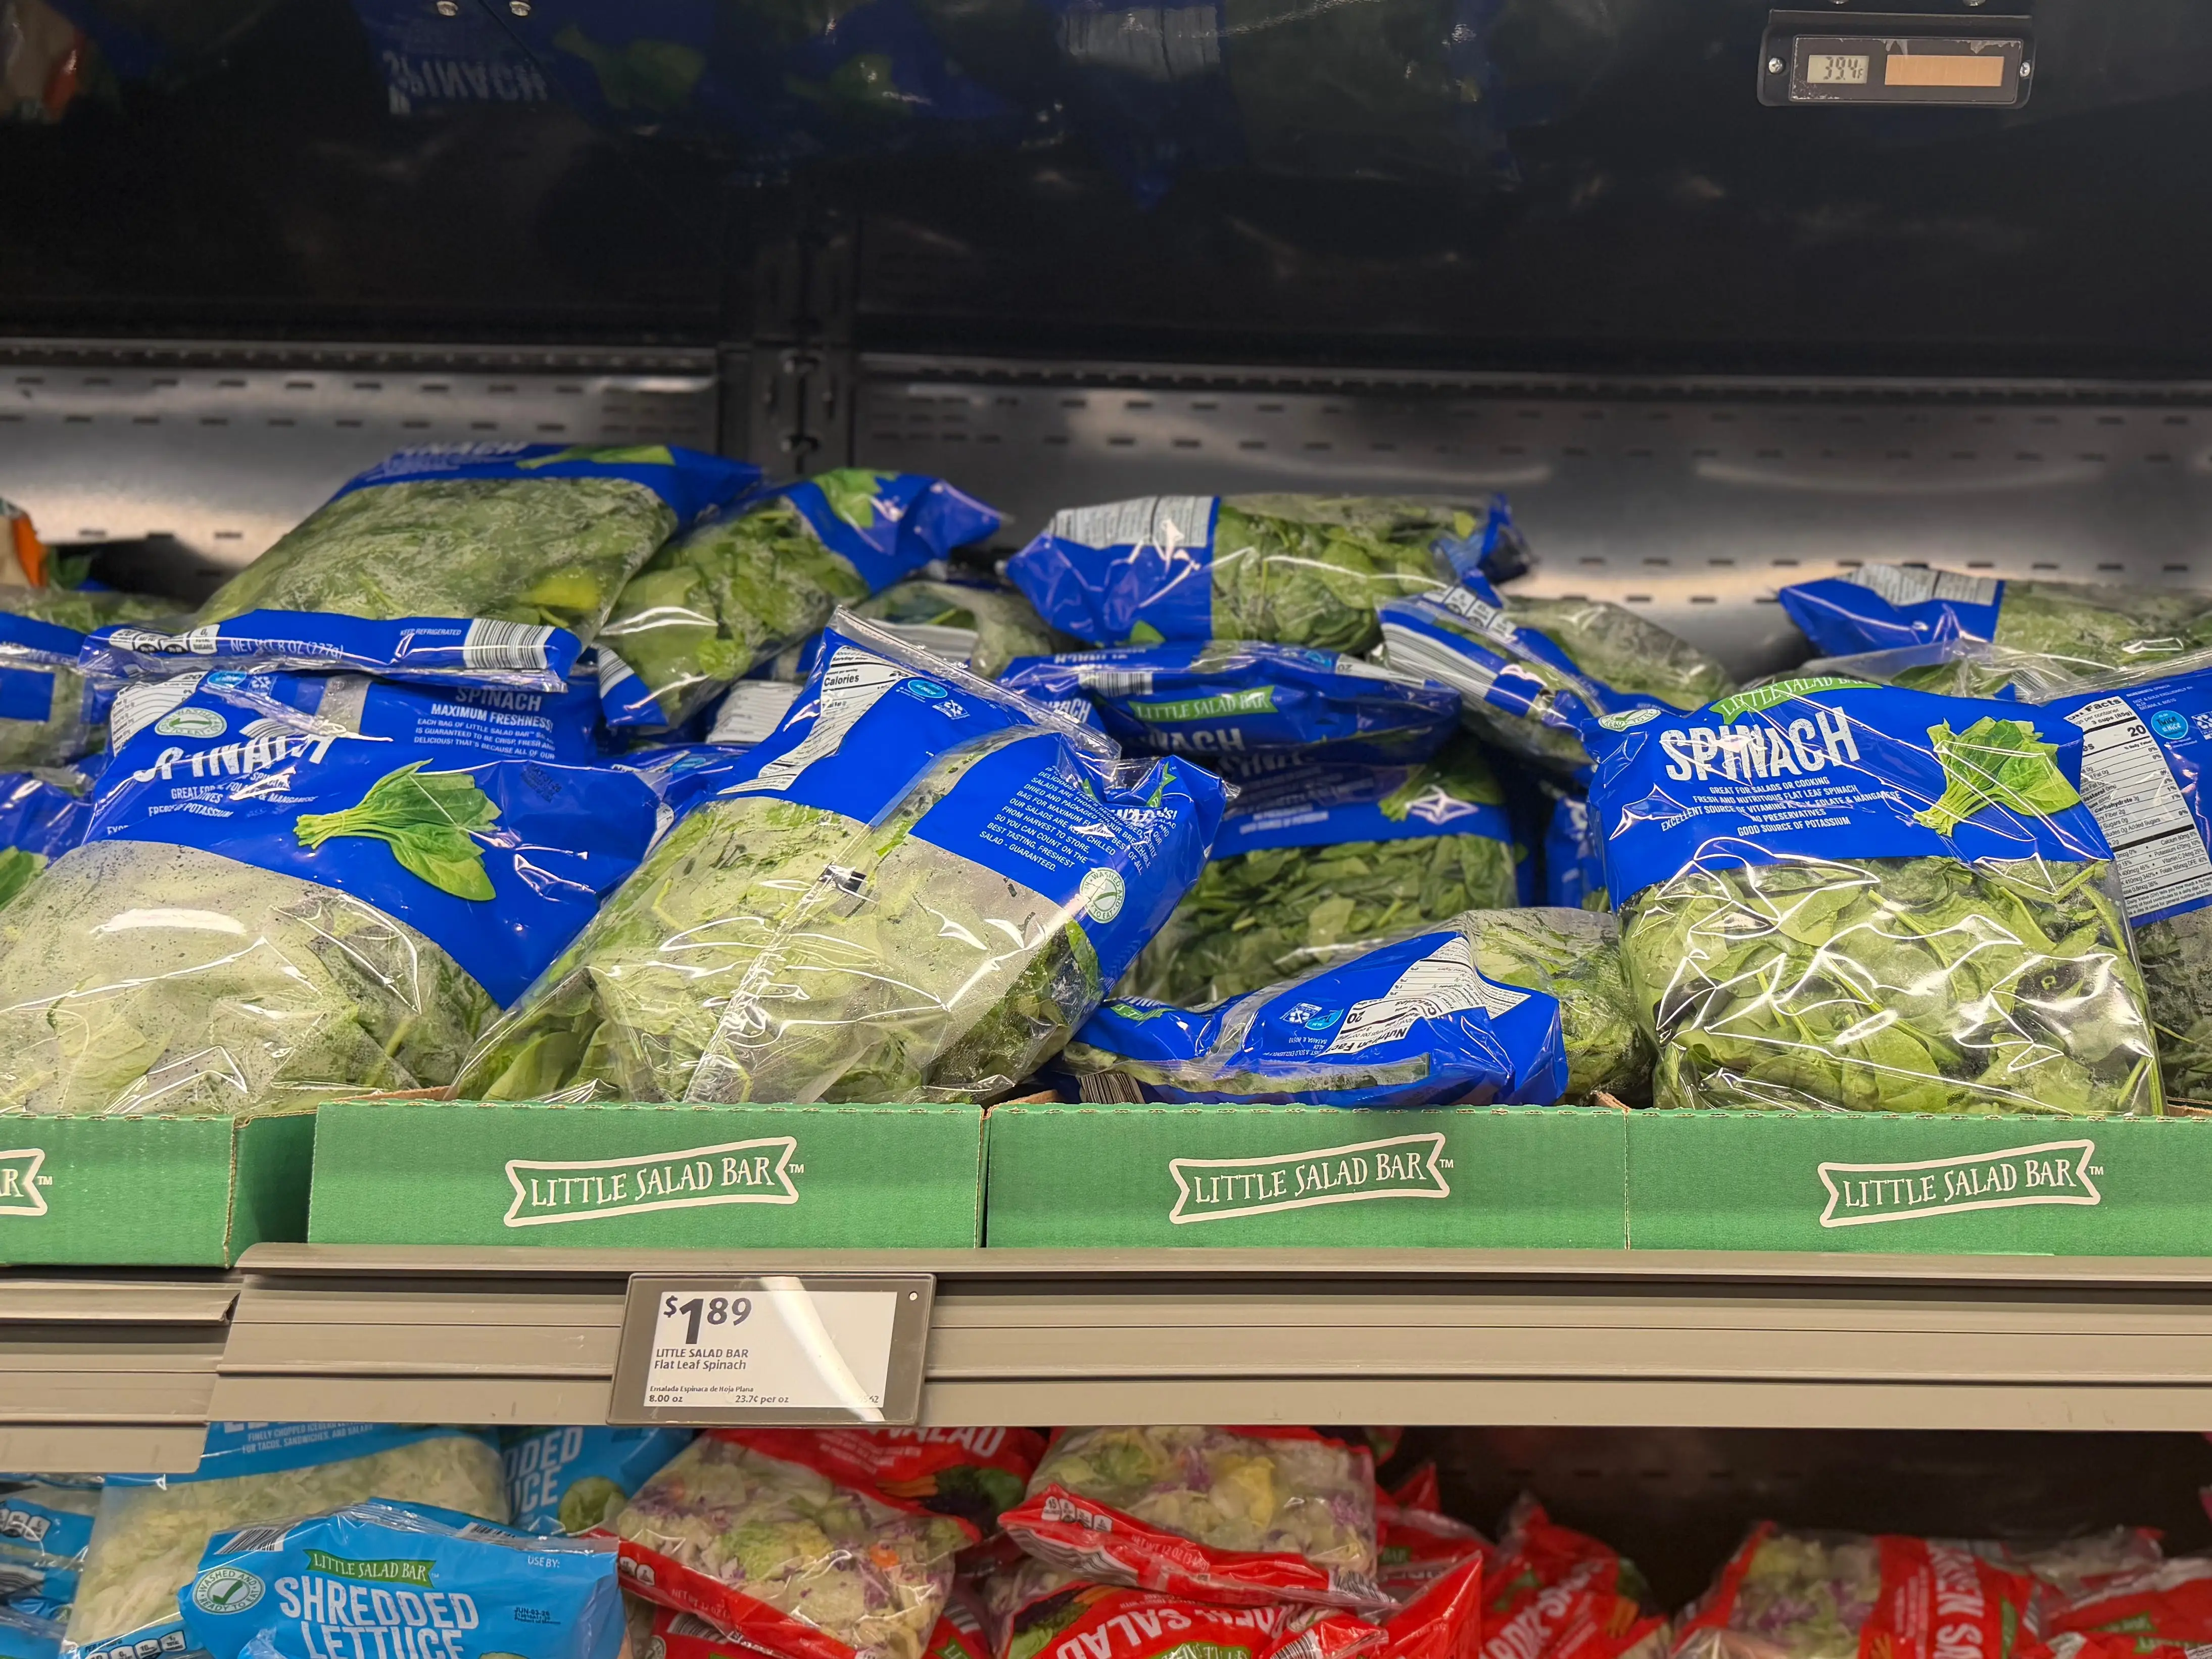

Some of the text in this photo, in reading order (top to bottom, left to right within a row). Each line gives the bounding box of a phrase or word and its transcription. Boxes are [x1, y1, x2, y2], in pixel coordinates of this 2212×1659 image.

[277, 640, 284, 652] 8
[288, 641, 303, 653] OZ
[824, 674, 859, 687] Calories
[455, 687, 543, 712] SPINACH
[1136, 699, 1189, 721] LITTLE
[1192, 695, 1236, 716] SALAD
[1720, 682, 1784, 716] LITTLE
[2085, 698, 2122, 712] Facts
[430, 703, 554, 733] MAXIMUM FRESHNESS!
[424, 728, 472, 739] GUARANTEED
[2127, 724, 2147, 737] 20
[480, 742, 514, 754] BECAUSE
[540, 751, 555, 760] OUR
[1660, 706, 1861, 781] SPINACH
[1031, 777, 1074, 799] SALADS ARE
[1693, 785, 1859, 804] FRESH AND NUTRITIOUS FLAT LEAF SPINACH
[1709, 786, 1735, 794] GREAT
[1752, 783, 1783, 794] SALADS
[1783, 781, 1795, 789] OR
[1795, 777, 1830, 787] COOKING
[1024, 784, 1046, 796] DRIED
[1045, 792, 1062, 803] AND
[1061, 798, 1098, 820] PACKAGED
[1661, 805, 1703, 832] EXCELLENT
[1704, 805, 1736, 814] SOURCE
[1746, 802, 1786, 813] VITAMINS
[1815, 797, 1844, 808] FOLATE
[1844, 795, 1853, 803] &
[1854, 790, 1902, 803] MANGANESE
[1016, 790, 1136, 861] BAG FOR MAXIMUM OF
[1764, 809, 1826, 822] PRESERVATIVES
[1001, 805, 1091, 854] FROM HARVEST TO STORE,
[1009, 797, 1026, 809] OUR
[1025, 805, 1054, 821] SALADS
[1052, 817, 1069, 828] ARE
[1086, 835, 1117, 856] CHILLED
[1737, 816, 1851, 837] GOOD SOURCE OF POTASSIUM
[2128, 822, 2144, 831] Added
[986, 822, 1075, 868] BEST TASTING, FRESHEST
[994, 814, 1089, 864] SO YOU CAN COUNT ON THE
[979, 830, 1056, 872] SALAD GUARANTEED.
[1091, 871, 1121, 887] WASHED
[1093, 908, 1101, 918] TO
[1102, 910, 1113, 919] EAT
[1346, 1011, 1365, 1024] 20
[531, 1157, 775, 1207] LITTLE SALAD BAR
[1194, 1153, 1427, 1203] LITTLE SALAD BAR
[1843, 1159, 2077, 1208] LITTLE SALAD BAR
[656, 1348, 748, 1359] LITTLE SALAD BAR
[654, 1359, 746, 1372] Flat Leaf Spinach
[649, 1395, 670, 1403] 8.00
[736, 1395, 758, 1403] 23.7¢
[760, 1396, 777, 1405] per
[680, 1386, 708, 1394] Espinaca
[719, 1386, 735, 1394] Hoja
[248, 1430, 273, 1442] FINELY
[273, 1424, 305, 1439] CHOPPED
[243, 1445, 257, 1454] FOR
[312, 1552, 427, 1582] LITTLE SALAD BAR
[527, 1555, 560, 1569] USE BY:
[199, 1570, 257, 1592] WASHED AND
[199, 1598, 229, 1611] READY
[247, 1589, 259, 1602] EAT
[274, 1575, 480, 1630] SHREDDED
[301, 1622, 464, 1659] LETTUCE
